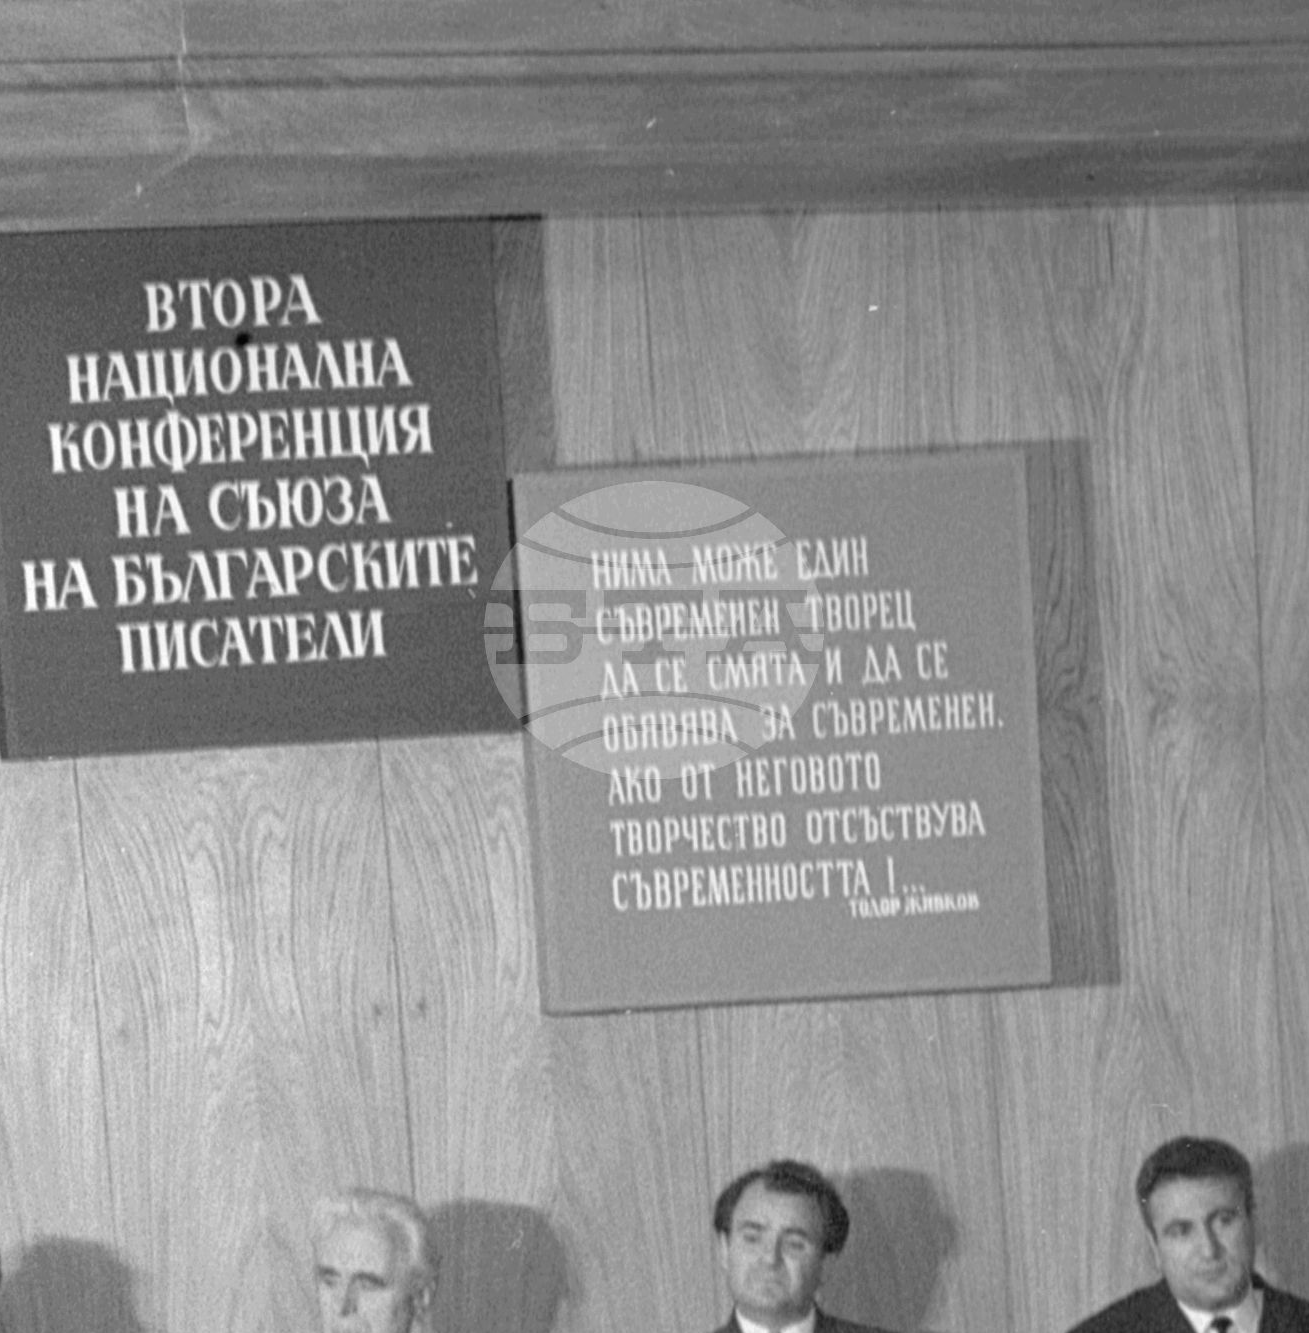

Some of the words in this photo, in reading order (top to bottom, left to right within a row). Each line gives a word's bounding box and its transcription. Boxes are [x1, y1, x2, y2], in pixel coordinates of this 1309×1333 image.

[143, 274, 322, 332] ВТОРА
[67, 337, 412, 406] НАЦИОНАЛНА
[48, 404, 433, 474] КОНФЕРЕНЦИЯ
[114, 484, 190, 538] НА
[208, 474, 391, 531] СЪЮЗА
[22, 558, 98, 612] НА
[111, 534, 478, 607] БЪЛГАРСКИТЕ
[591, 547, 673, 590] НИМА
[692, 541, 778, 584] МОЖЕ
[796, 536, 869, 581] ЕДИН
[117, 609, 387, 673] ПИСАТЕЛИ
[595, 597, 780, 645] СЪВРЕМЕНЕН
[803, 590, 916, 633] ТВОРЕЦ
[601, 660, 640, 701] ДА
[655, 656, 688, 694] СЕ
[707, 651, 807, 691] СМЯТА
[824, 648, 843, 684] И
[862, 643, 902, 685] ДА
[916, 640, 949, 680] СЕ
[602, 708, 738, 753] ОБЯВЯВА
[761, 705, 796, 743] ЗА
[608, 765, 662, 806] АКО
[680, 761, 714, 801] ОТ
[735, 751, 881, 799] НЕГОВОТО
[609, 811, 787, 857] ТВОРЧЕСТВО
[806, 800, 986, 845] ОТСЪСТВУВА
[612, 859, 871, 911] СЪВРЕМЕННОСТТА
